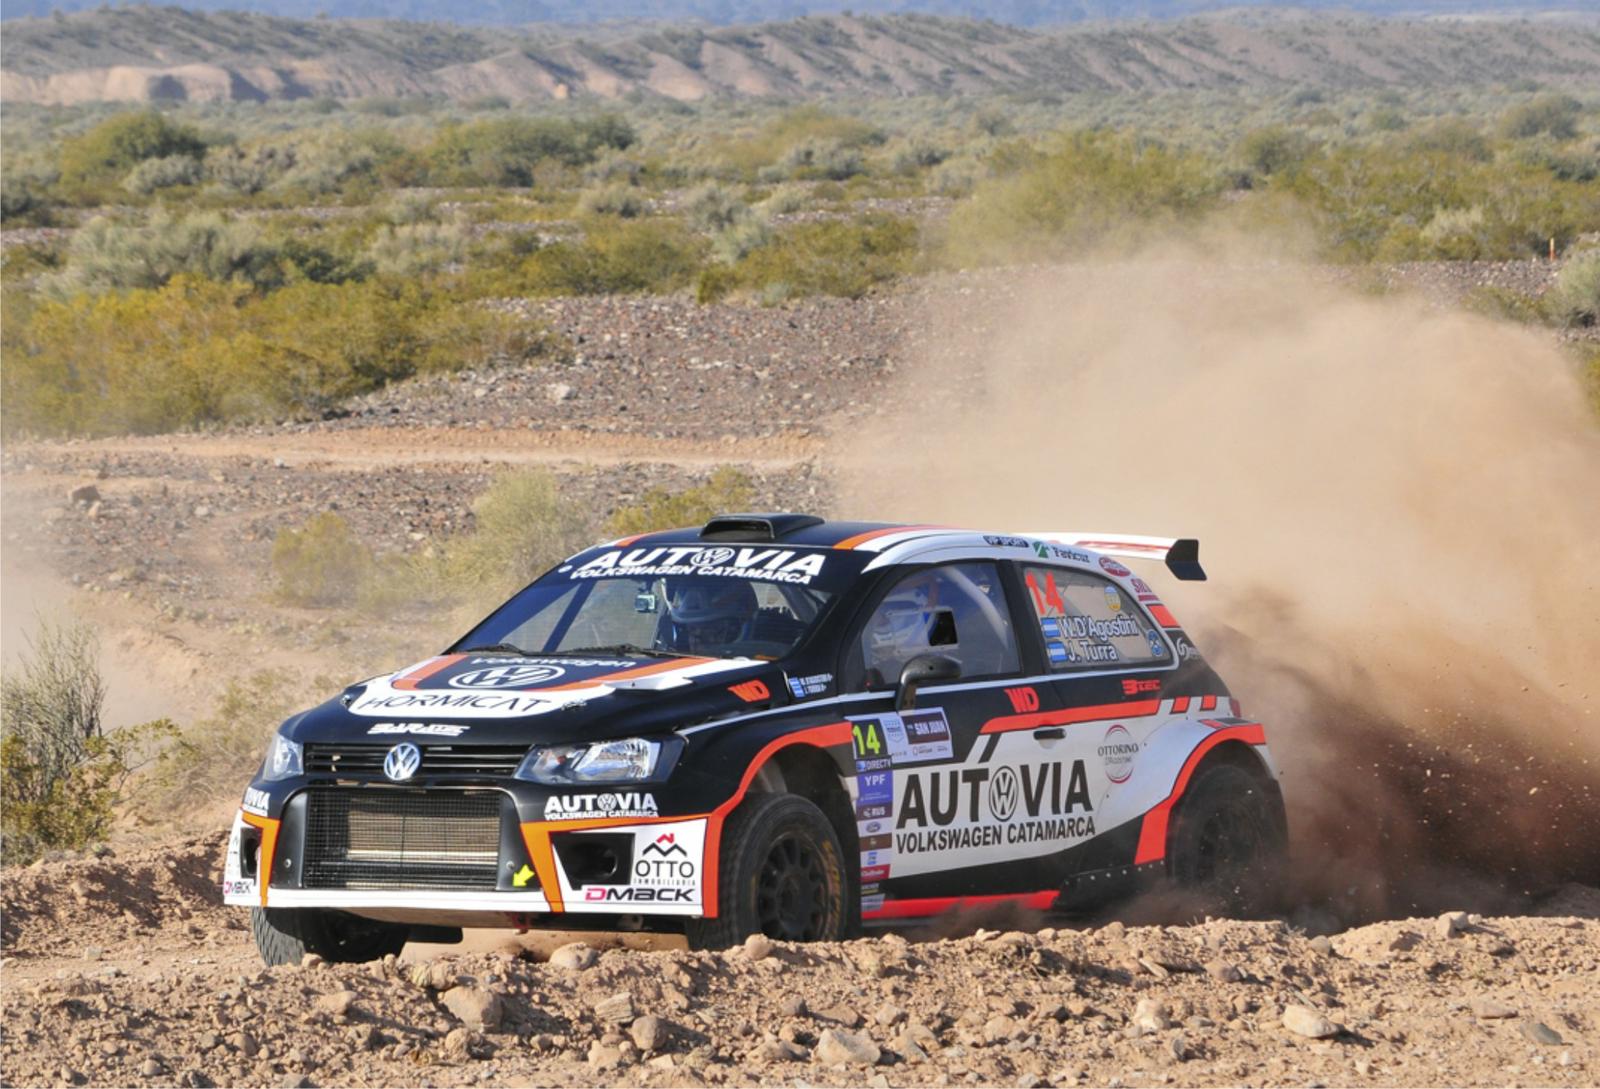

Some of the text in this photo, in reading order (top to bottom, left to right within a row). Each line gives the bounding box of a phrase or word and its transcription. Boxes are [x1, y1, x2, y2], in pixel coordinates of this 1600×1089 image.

[570, 565, 812, 585] VOLKSWAGEN CATAMARCA
[1025, 571, 1065, 616] 14
[1080, 640, 1118, 661] Turra
[357, 693, 555, 713] HORMICAT
[1004, 687, 1040, 714] WD
[852, 724, 881, 755] 14
[865, 774, 887, 787] YPF
[544, 810, 660, 821] VOLKSWAGEN CATAMARCA
[896, 815, 1096, 855] VOLKSWAGEN CATAMARCA
[635, 859, 695, 878] OTTO
